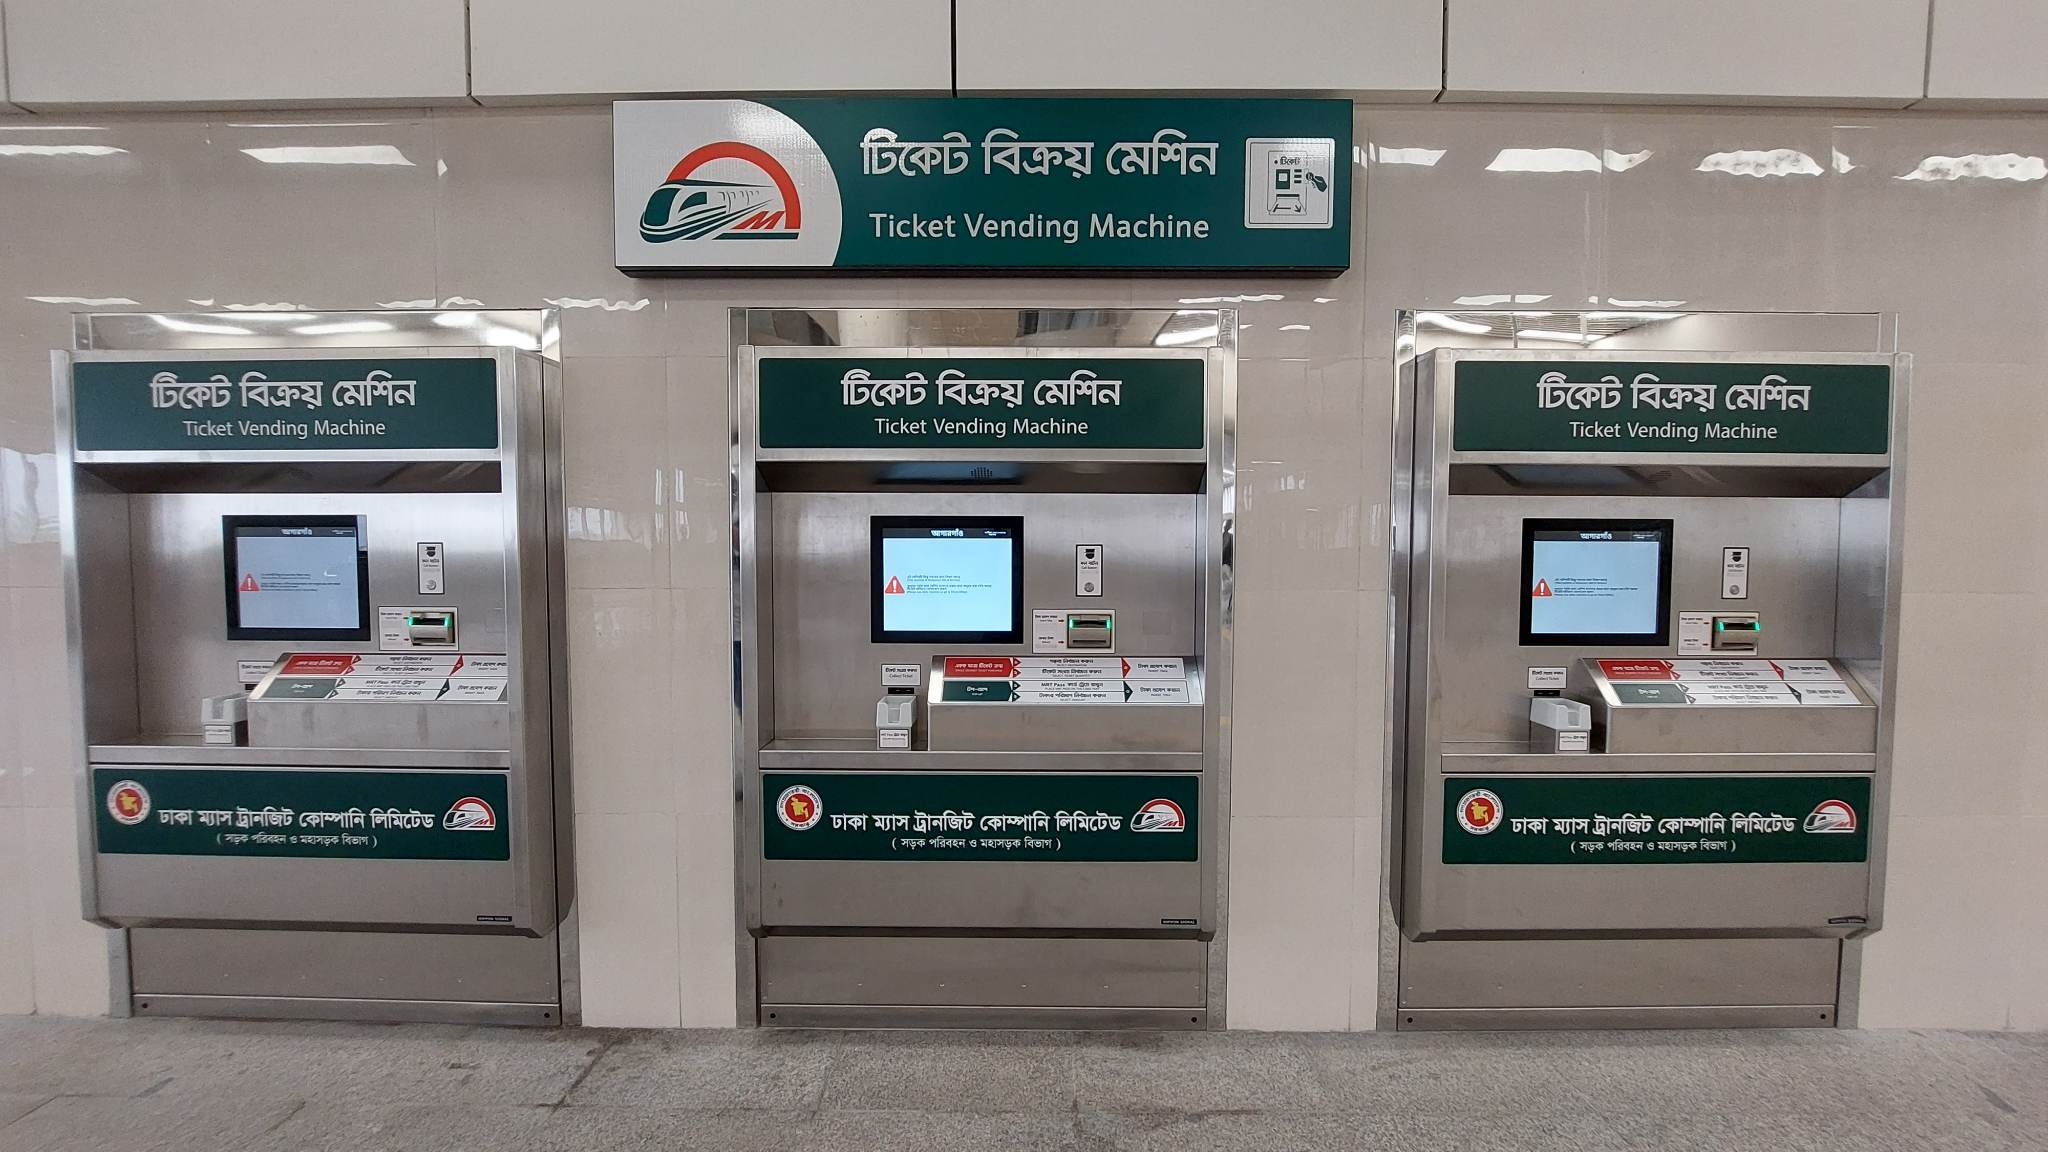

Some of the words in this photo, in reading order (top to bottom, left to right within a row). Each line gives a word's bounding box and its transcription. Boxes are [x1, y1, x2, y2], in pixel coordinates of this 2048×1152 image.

[860, 128, 971, 176] টিকেট
[981, 129, 1094, 178] বিক্রয়
[1106, 129, 1219, 175] মেশিন
[869, 214, 955, 237] Ticket
[964, 214, 1078, 243] Vending
[1090, 214, 1209, 238] Machine
[150, 372, 232, 409] টিকেট
[239, 372, 323, 409] বিক্রয়
[332, 370, 416, 406] মেশিন
[841, 369, 928, 406] টিকেট
[936, 369, 1024, 408] বিক্রয়
[1034, 370, 1122, 405] মেশিন
[1537, 372, 1623, 409] টিকেট
[1630, 373, 1717, 412] বিক্রয়
[1726, 375, 1811, 410] মেশিন
[183, 421, 233, 436] Ticket
[238, 420, 307, 439] Vending
[315, 419, 385, 435] Machine
[875, 418, 927, 434] Ticket
[934, 418, 1006, 438] Vending
[1014, 418, 1088, 434] Machine
[1570, 422, 1620, 437] Ticket
[1627, 422, 1698, 442] Vending
[1705, 423, 1777, 438] Machine
[158, 810, 194, 825] ঢাকা
[197, 811, 233, 826] ম্যাস
[236, 806, 295, 828] ট্রানজিট
[299, 808, 366, 828] কোম্পানি
[369, 808, 435, 828] লিমিটেড
[830, 813, 868, 830] ঢাকা
[872, 814, 910, 831] ম্যাস
[913, 810, 975, 833] ট্রানজিট
[980, 811, 1050, 831] কোম্পানি
[1054, 811, 1123, 831] লিমিটেড
[1510, 817, 1549, 834] ঢাকা
[1552, 818, 1590, 834] ম্যাস
[1592, 813, 1654, 836] ট্রানজিট
[1658, 813, 1727, 833] কোম্পানি
[1730, 812, 1797, 833] লিমিটেড
[901, 839, 925, 849] সড়ক
[929, 836, 965, 848] পরিবহন
[980, 839, 1021, 850] মহাসড়ক
[1024, 836, 1052, 848] বিভাগ
[1579, 842, 1604, 852] সড়ক
[1607, 839, 1643, 851] পরিবহন
[1647, 842, 1654, 850] ও
[1657, 842, 1697, 852] মহাসড়ক
[1700, 838, 1727, 850] বিভাগ
